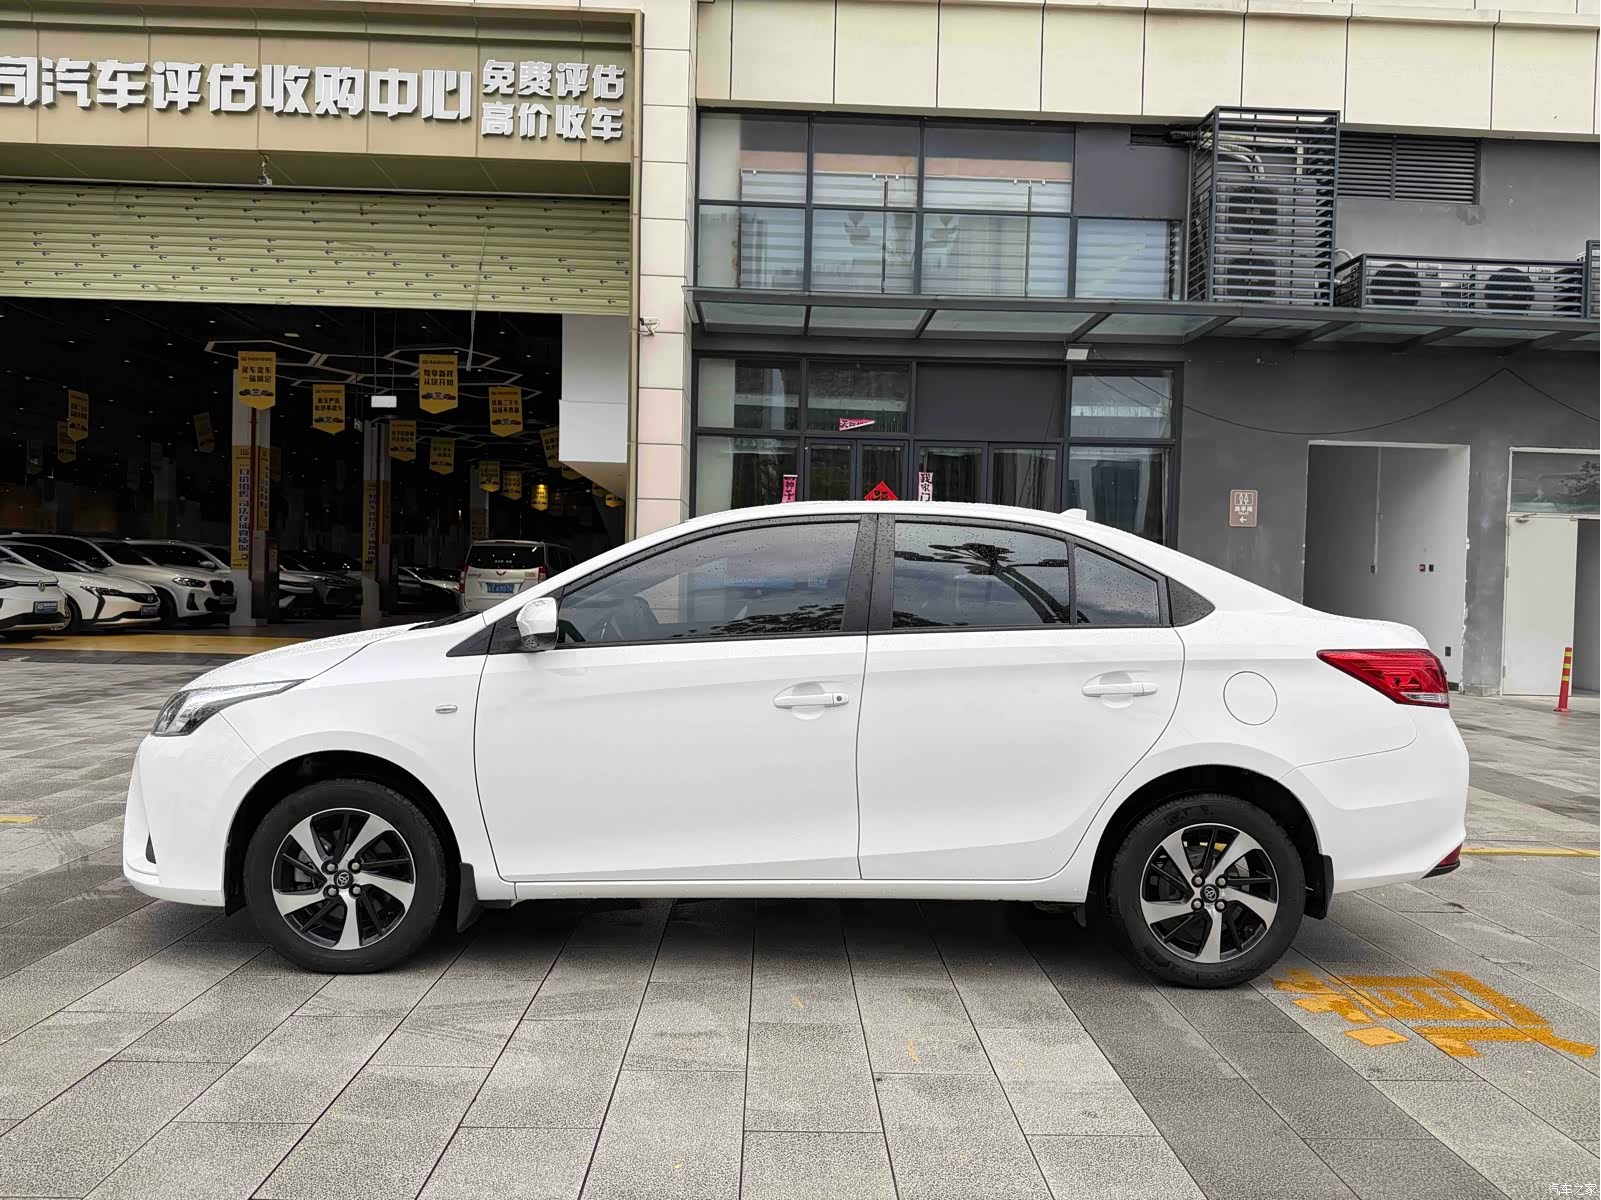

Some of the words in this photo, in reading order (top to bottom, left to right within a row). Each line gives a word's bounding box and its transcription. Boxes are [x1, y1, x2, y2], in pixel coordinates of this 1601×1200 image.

[482, 59, 626, 100] 免费评估
[481, 101, 625, 141] 高价收车
